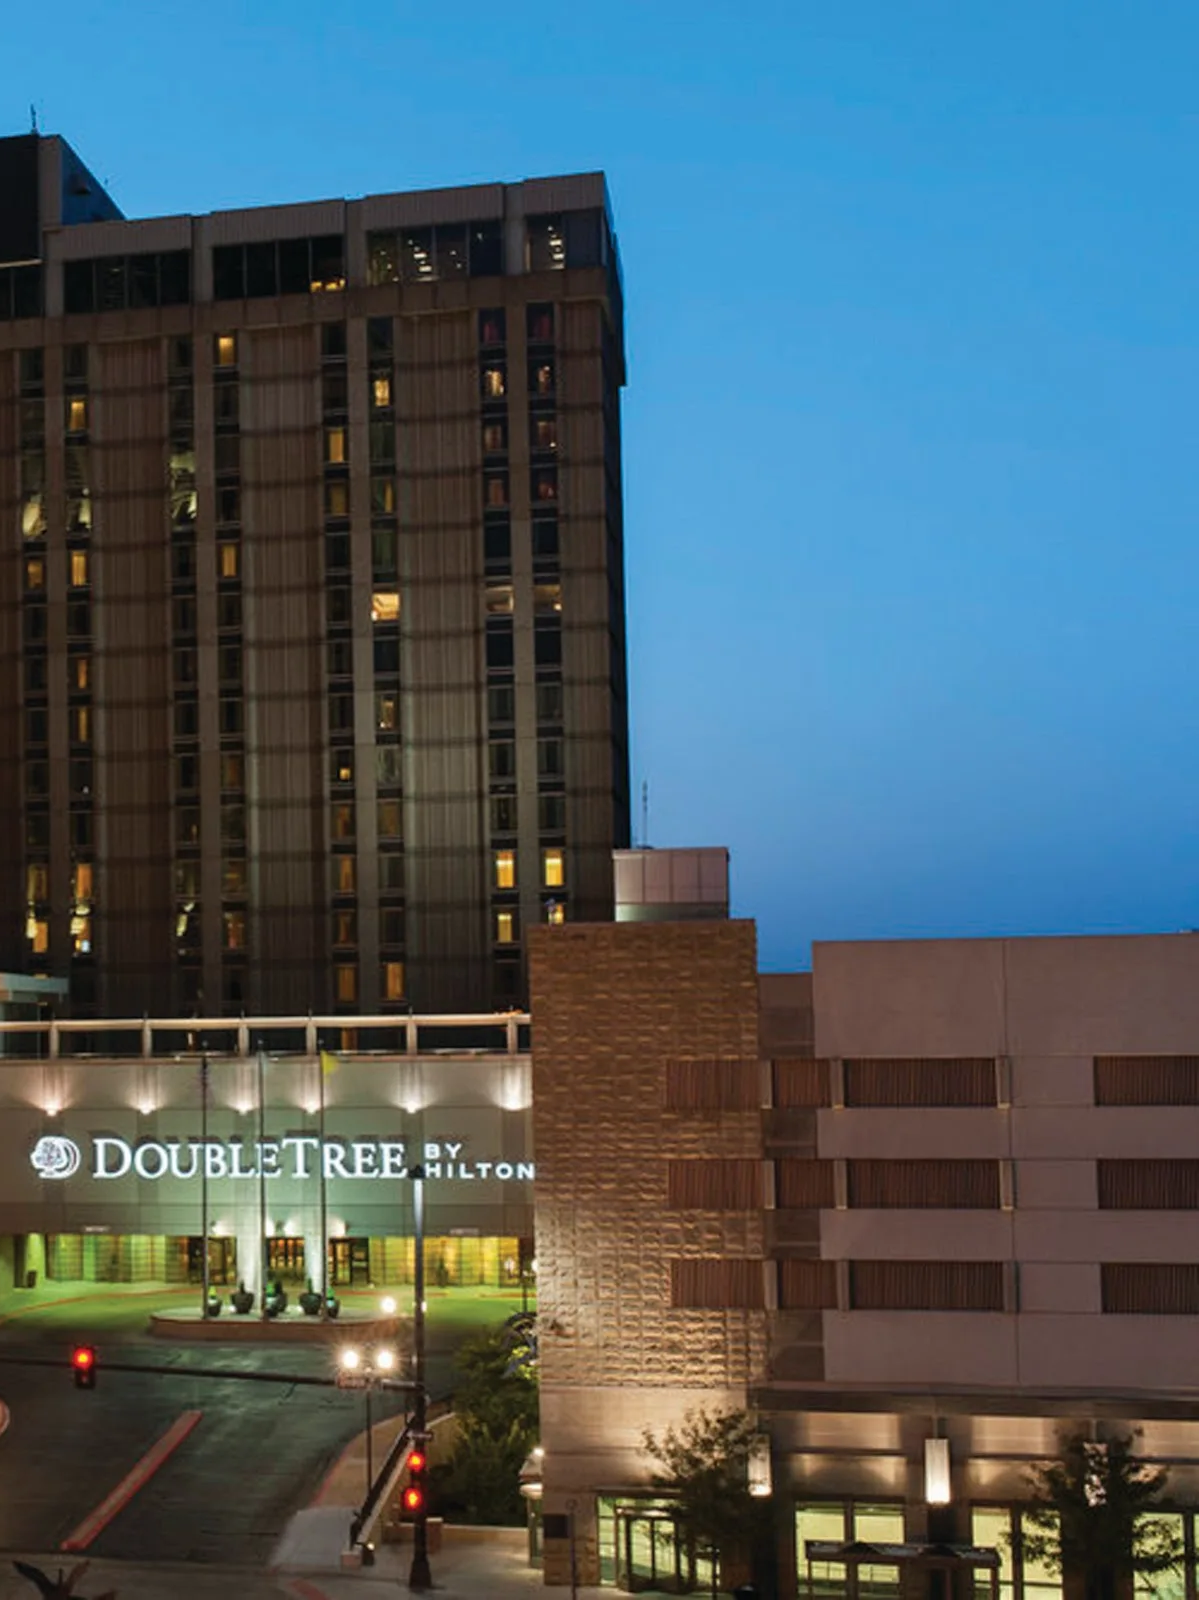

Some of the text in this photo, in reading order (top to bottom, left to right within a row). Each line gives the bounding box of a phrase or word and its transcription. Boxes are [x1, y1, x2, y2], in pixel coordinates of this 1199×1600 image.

[93, 1137, 408, 1179] DOUBLETREE
[424, 1143, 462, 1159] BY
[424, 1162, 536, 1179] HILTON
